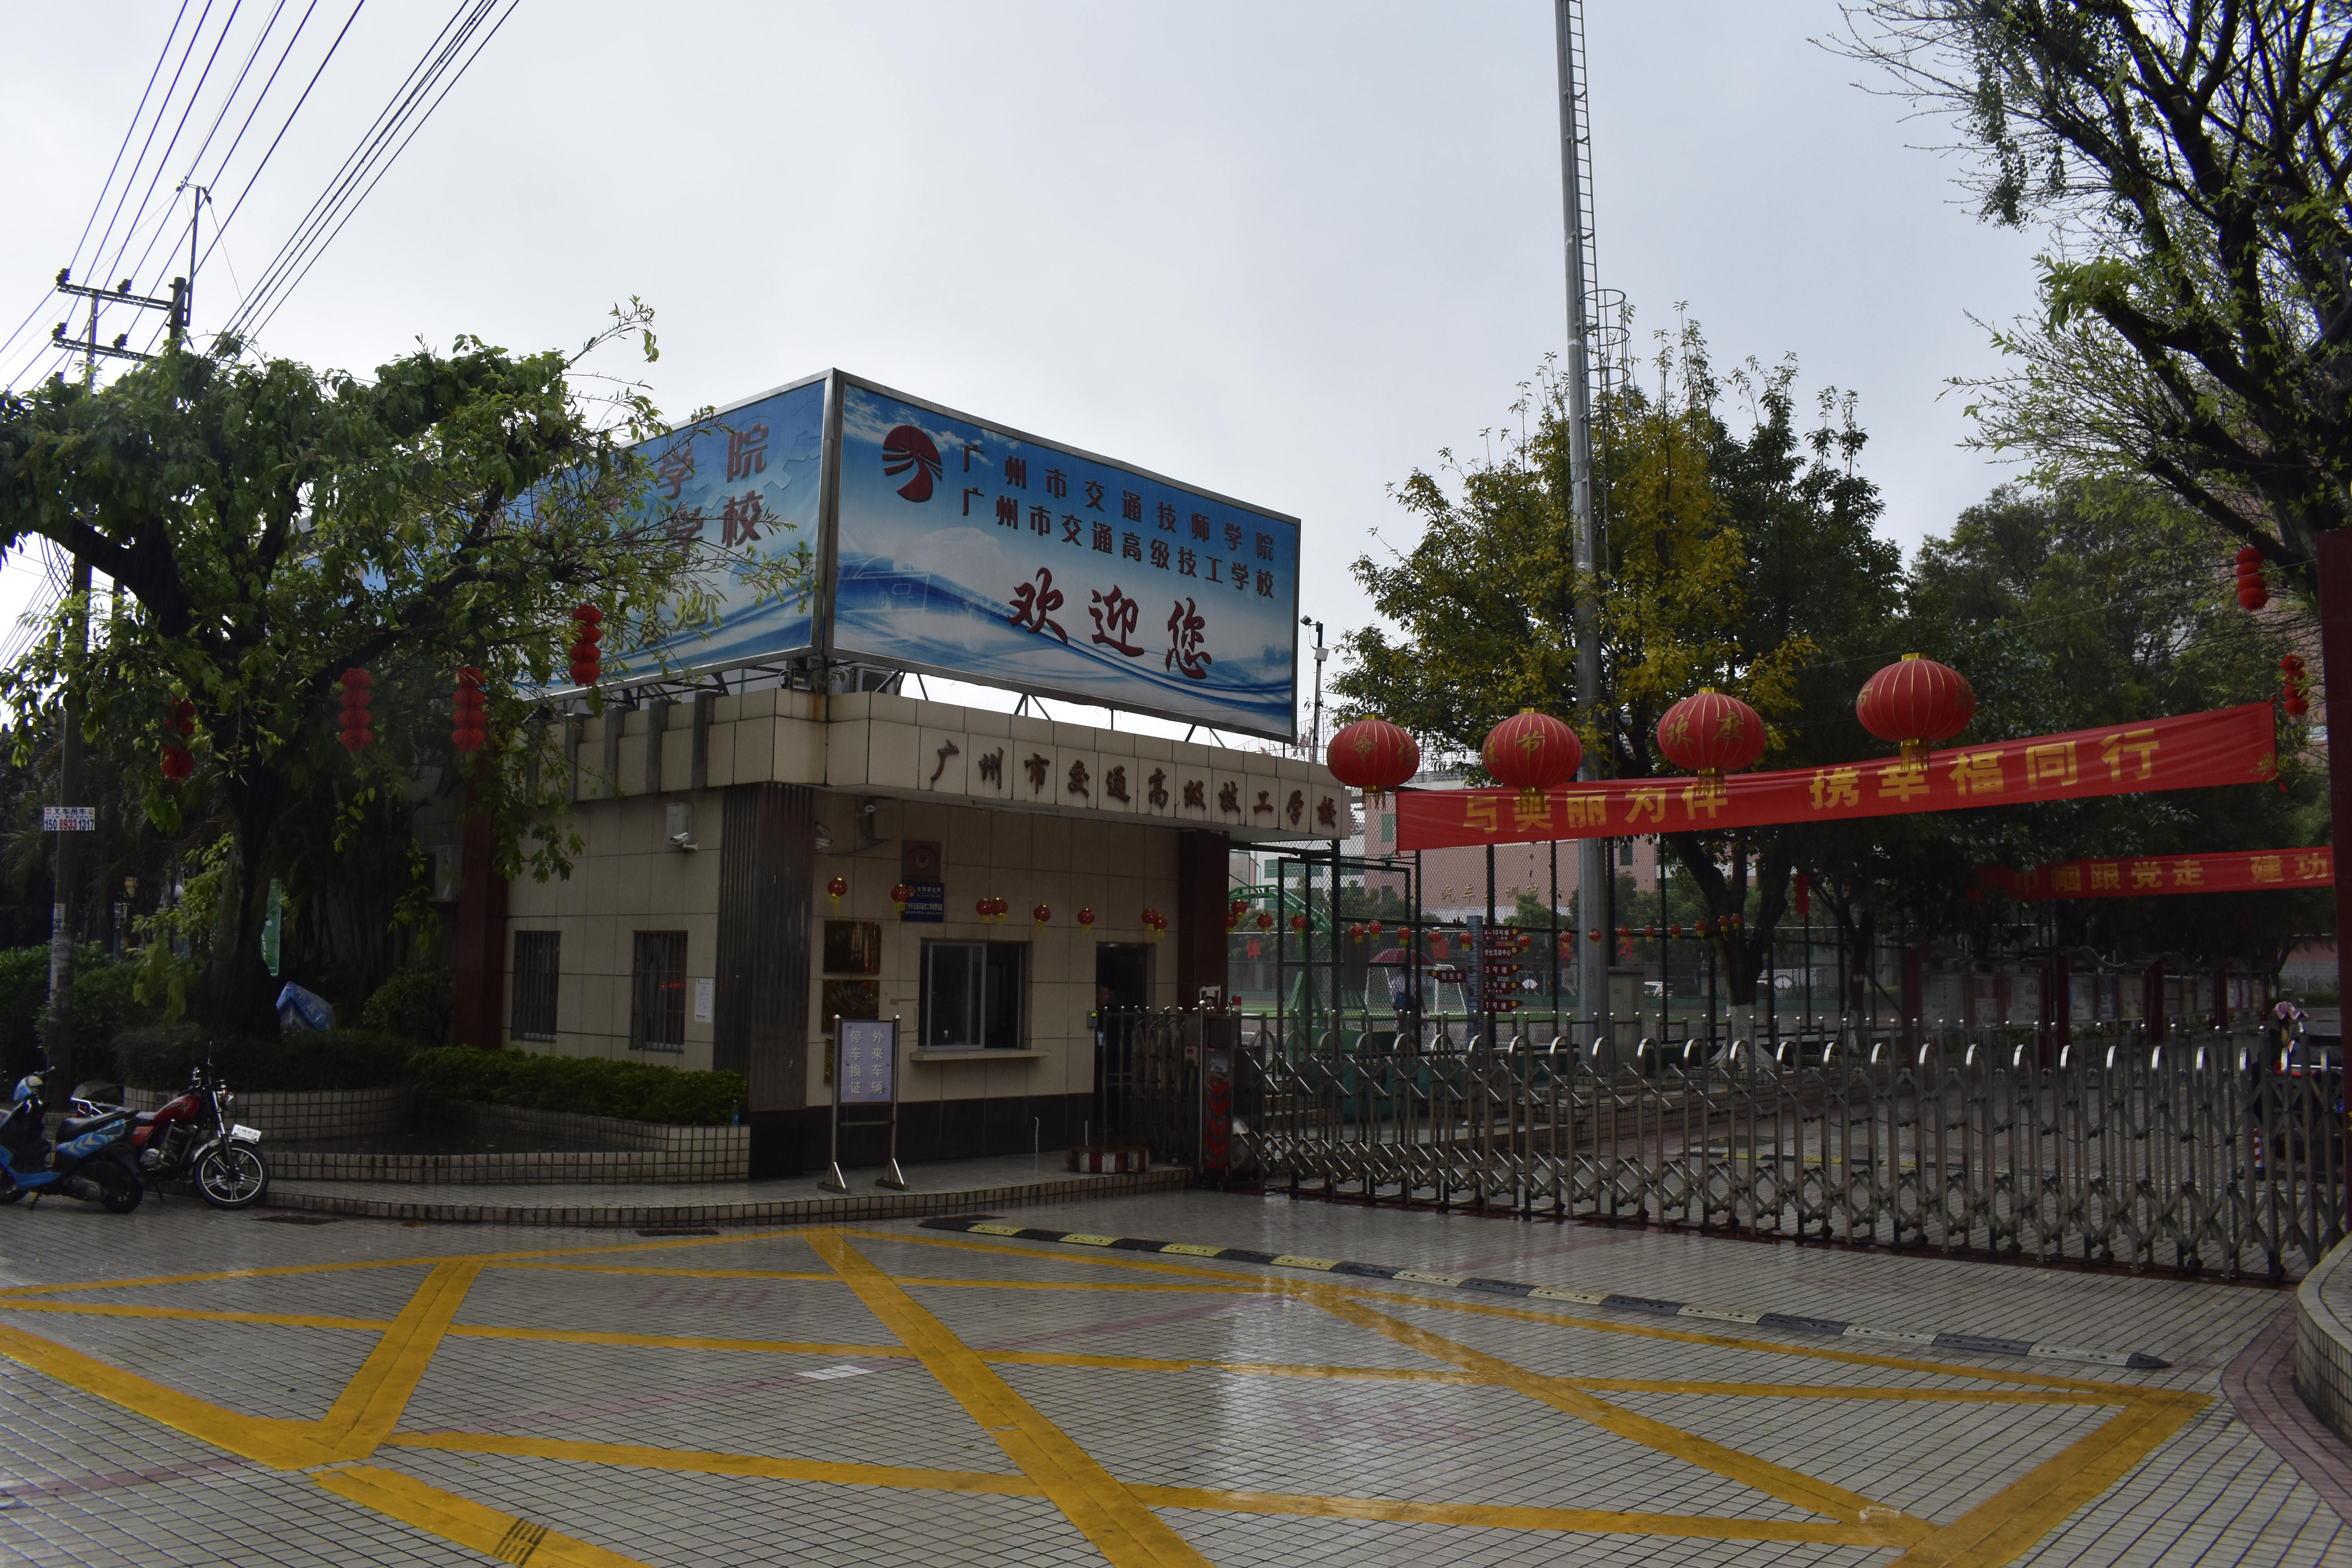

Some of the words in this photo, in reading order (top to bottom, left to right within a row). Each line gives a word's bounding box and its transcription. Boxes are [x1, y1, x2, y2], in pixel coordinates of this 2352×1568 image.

[963, 444, 1274, 562] 广州市交通技师学院
[962, 487, 1274, 600] 广州市交通高级技工学校
[1008, 566, 1212, 680] 欢迎您
[1483, 730, 1546, 766] 佳节
[1665, 710, 1746, 746] 欢度
[931, 739, 1337, 828] 广州市交通高级技工学校
[1463, 782, 1729, 835] 与美丽为伴
[1809, 728, 2160, 810] 携幸福同行
[45, 819, 57, 830] 150
[59, 819, 77, 830] 8933
[79, 819, 94, 830] 1317
[2250, 852, 2329, 883] 建功
[849, 1029, 862, 1095] 停车换证
[871, 1030, 884, 1094] 外来车辆
